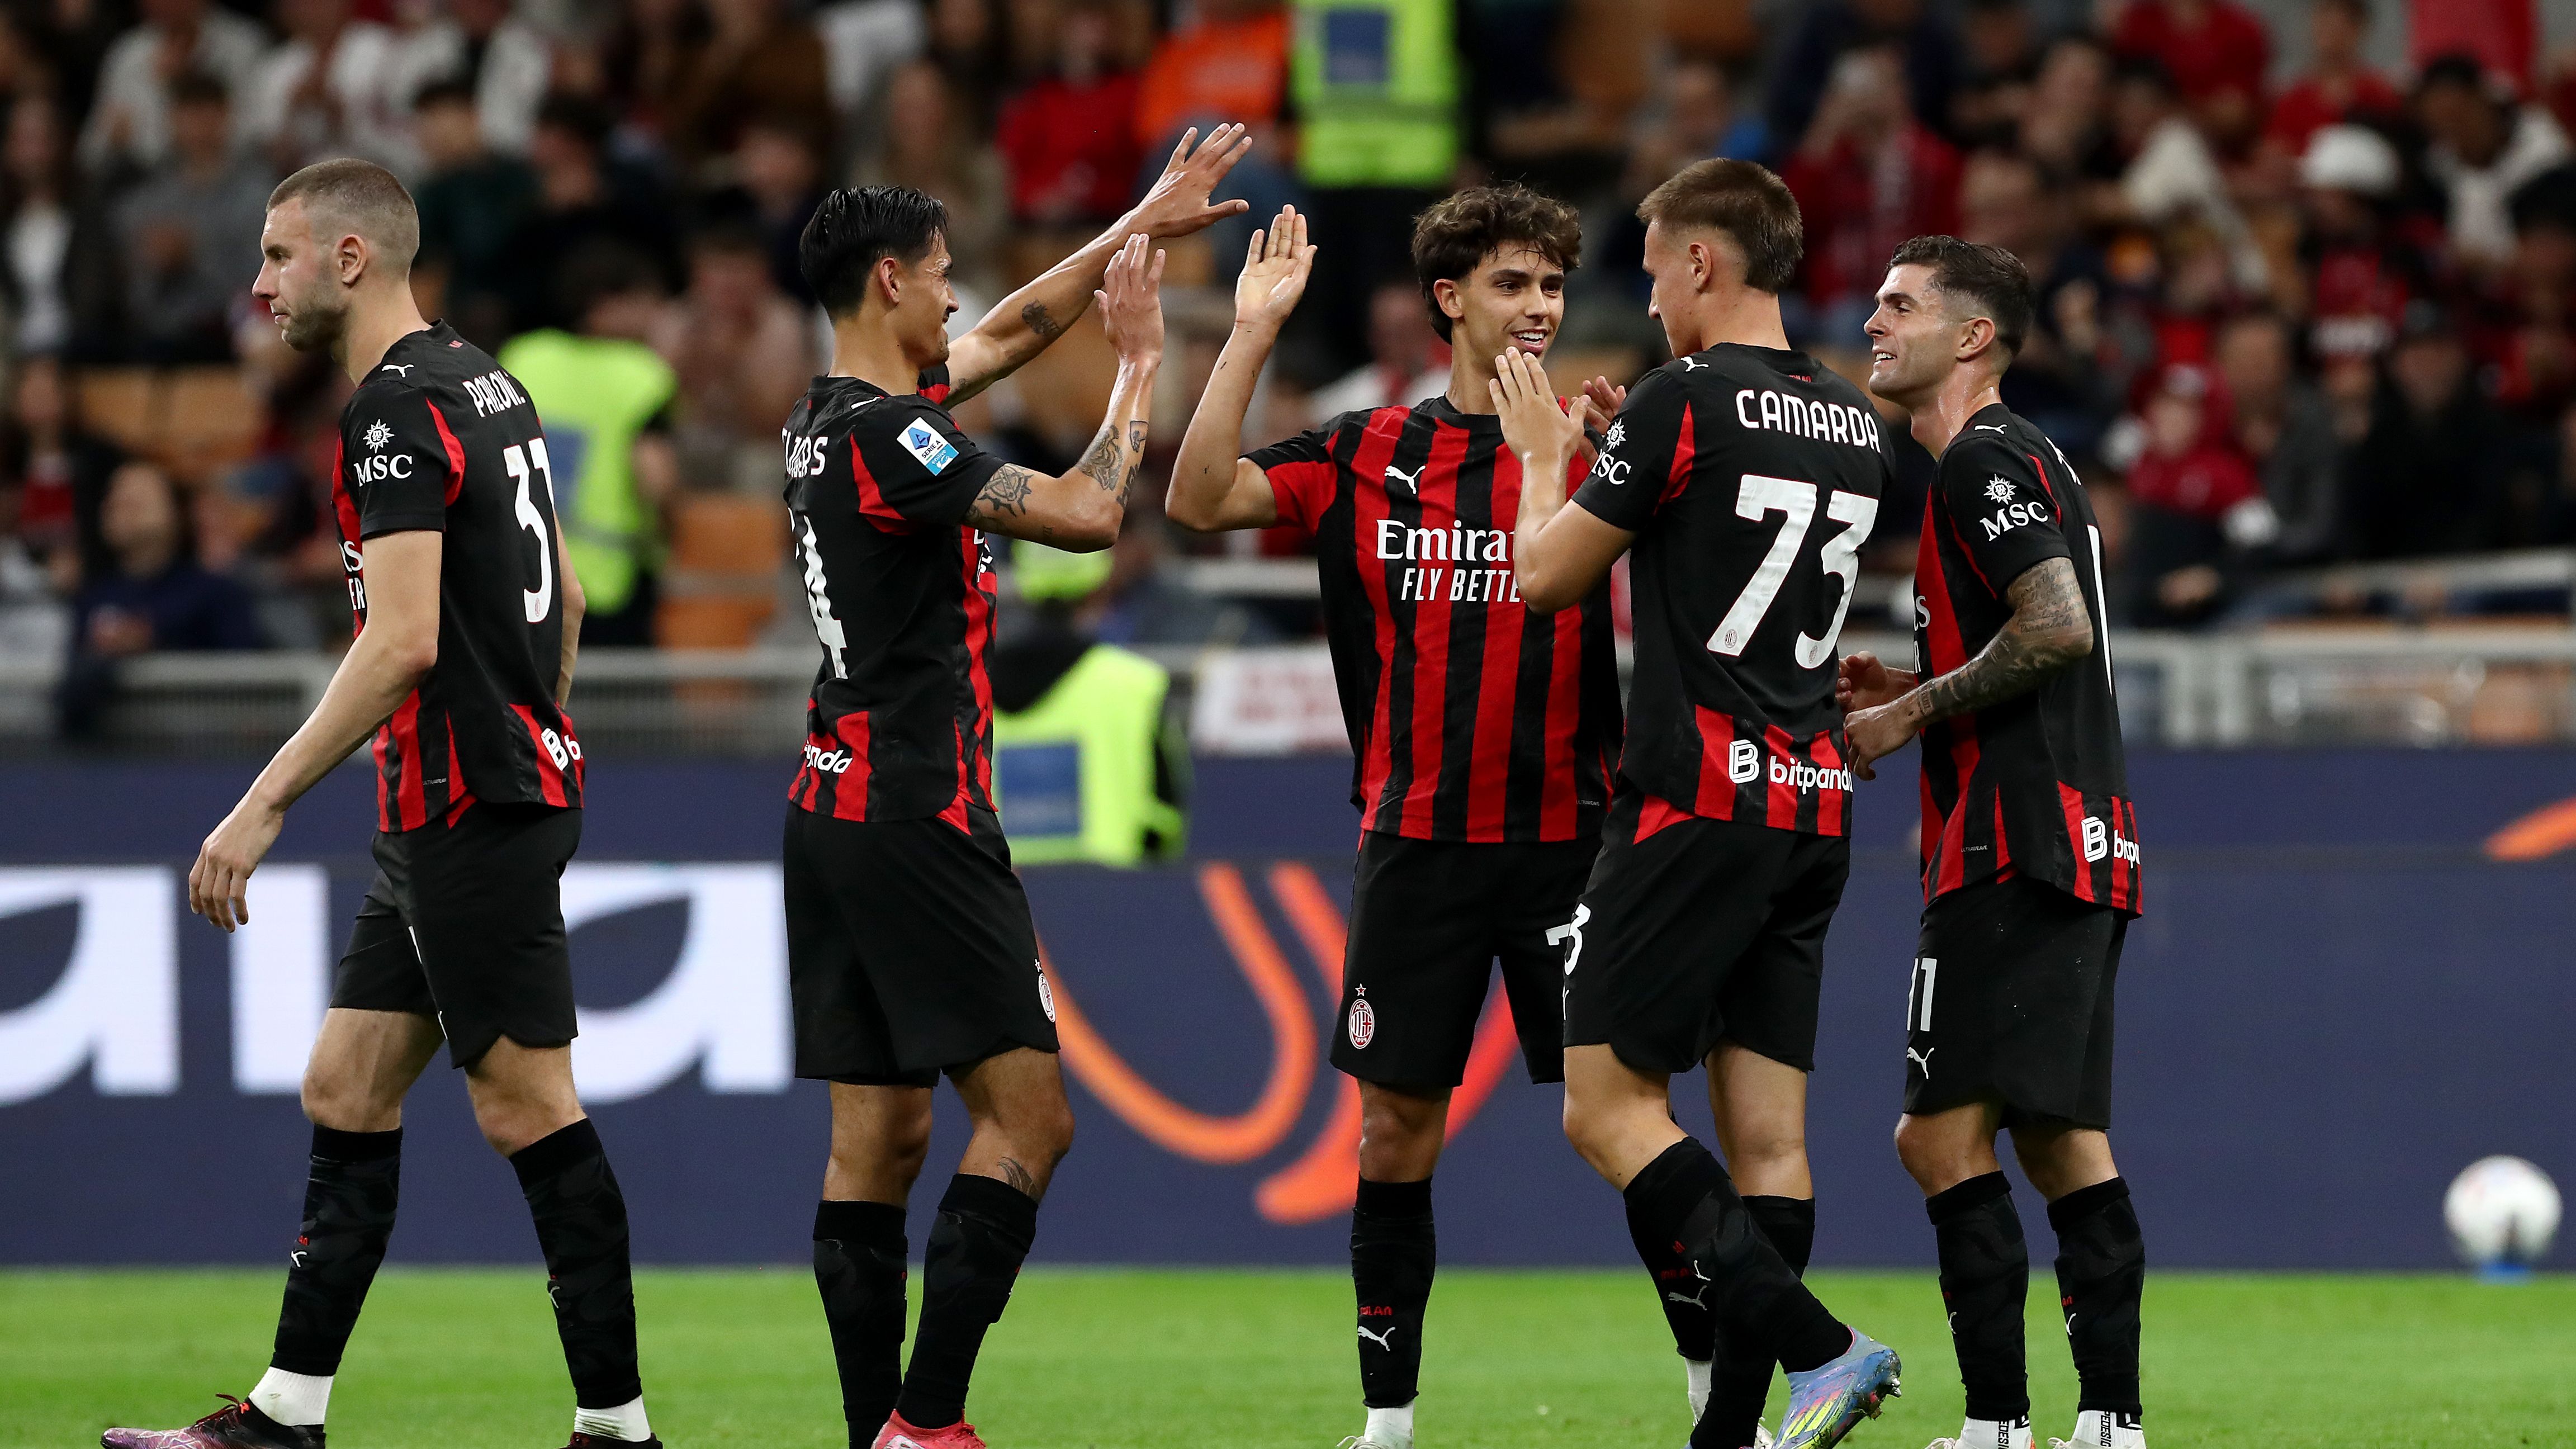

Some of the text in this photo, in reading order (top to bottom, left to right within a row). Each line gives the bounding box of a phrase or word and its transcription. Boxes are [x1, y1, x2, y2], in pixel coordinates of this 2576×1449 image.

[1735, 390, 1881, 453] CAMARDA
[353, 454, 414, 487] MSC
[921, 443, 937, 458] SERIE
[1376, 519, 1515, 562] Emira
[1980, 501, 2049, 542] MSC
[1401, 568, 1526, 603] FLY BETTE
[1706, 474, 1879, 669] 73
